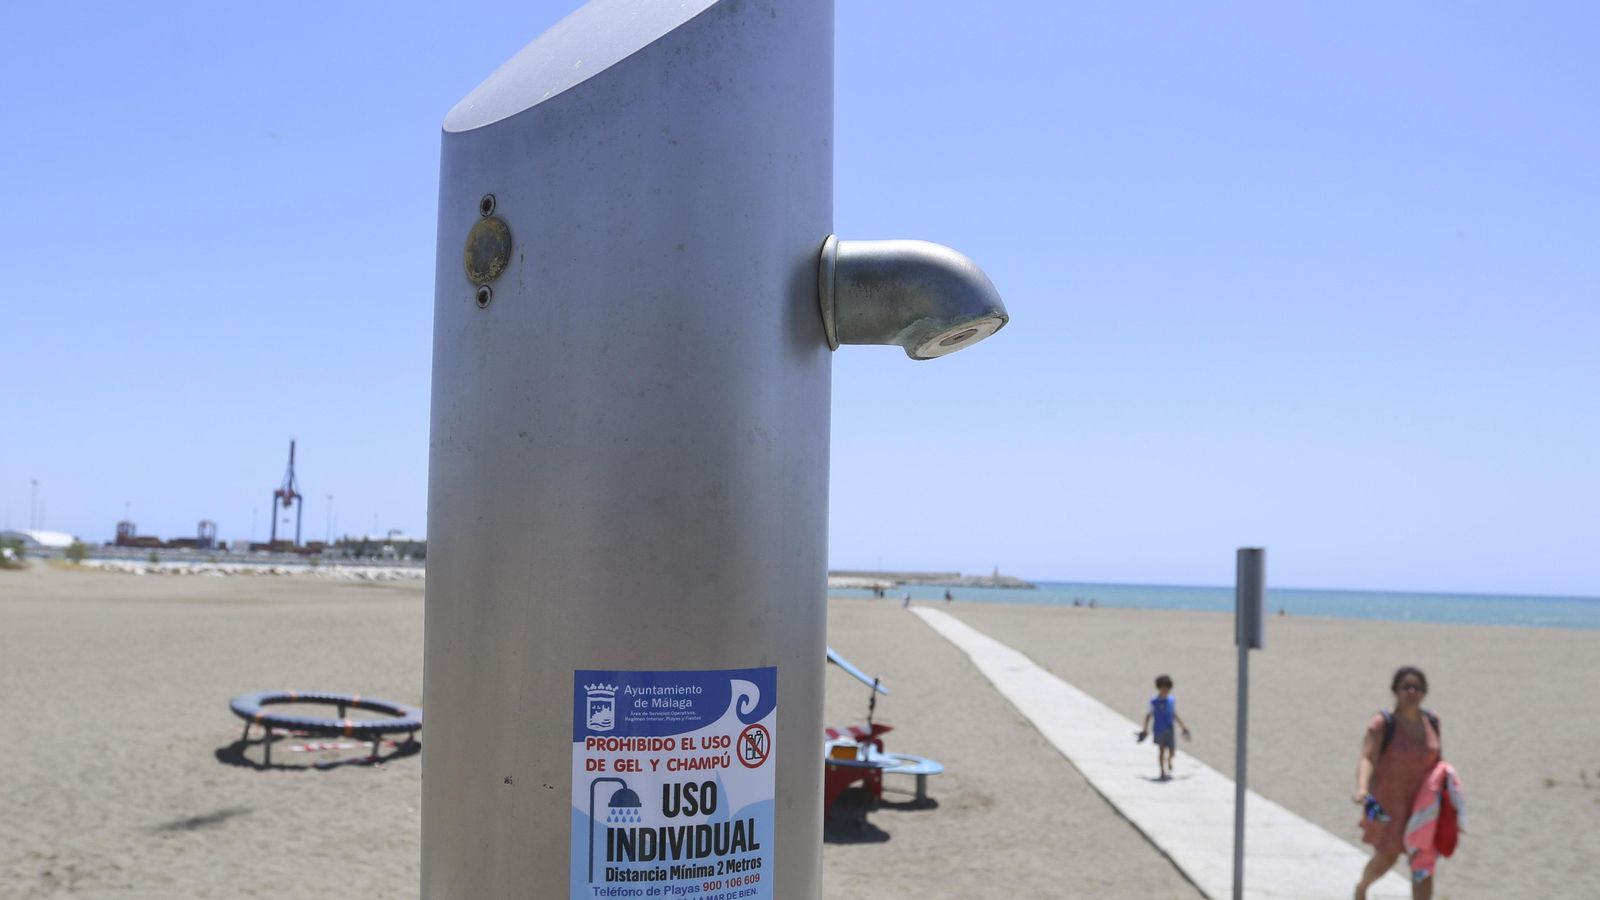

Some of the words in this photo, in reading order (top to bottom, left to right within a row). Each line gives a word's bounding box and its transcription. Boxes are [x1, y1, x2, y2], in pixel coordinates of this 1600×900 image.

[624, 685, 702, 696] Ayuntamiento
[634, 698, 648, 708] de
[652, 698, 692, 710] Málaga
[586, 737, 676, 752] PROHIBIDO
[681, 737, 697, 750] EL
[701, 735, 731, 749] USO
[586, 758, 606, 772] DE
[613, 758, 643, 772] GEL
[649, 758, 660, 772] Y
[666, 751, 731, 772] CHAMPÚ
[662, 780, 718, 818] USO
[606, 818, 760, 863] INDIVIDUAL
[606, 867, 667, 882] Distancia
[670, 863, 714, 880] Mínima
[717, 861, 724, 876] 2
[726, 857, 762, 874] Metros
[592, 886, 643, 897] Teléfono
[646, 886, 660, 896] de
[664, 885, 700, 896] Playas
[703, 880, 722, 892] 900
[725, 877, 742, 888] 106
[744, 873, 760, 885] 609
[726, 891, 738, 900] DE
